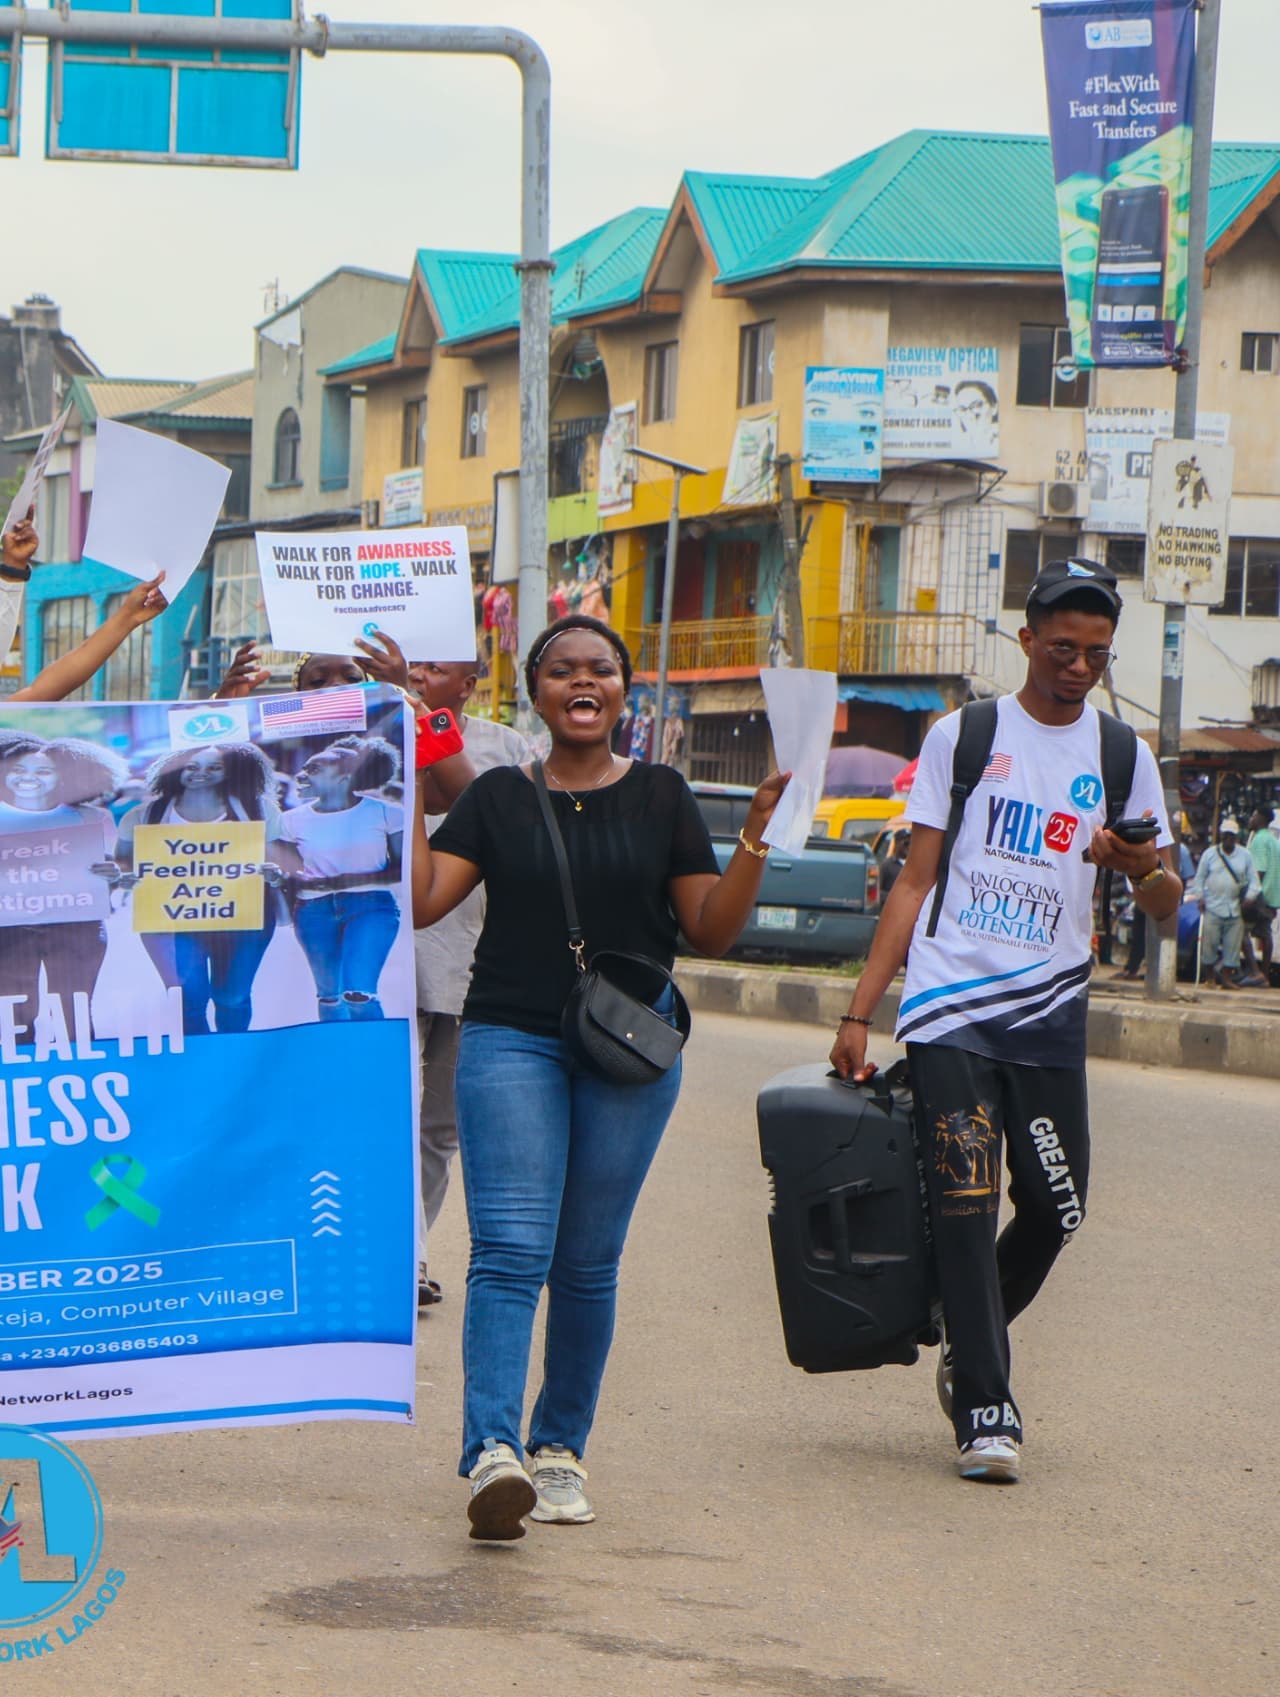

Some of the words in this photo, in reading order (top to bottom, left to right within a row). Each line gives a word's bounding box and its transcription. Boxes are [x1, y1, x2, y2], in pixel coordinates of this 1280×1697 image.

[1085, 73, 1160, 94] #FlexWith
[1069, 101, 1099, 118] Fast
[1102, 98, 1126, 116] and
[1130, 98, 1177, 116] Secure
[1093, 120, 1157, 139] Transfers
[1158, 523, 1173, 537] NO
[1176, 526, 1218, 540] TRADING
[273, 546, 317, 562] WALK
[322, 546, 352, 562] FOR
[357, 540, 456, 561] AWARENESS.
[1175, 540, 1221, 554] HAWKING
[276, 564, 320, 581] WALK
[325, 565, 355, 581] FOR
[360, 561, 406, 580] HOPE.
[412, 559, 458, 577] WALK
[1158, 554, 1172, 565] NO
[1174, 555, 1212, 570] BUYING
[316, 584, 346, 600] FOR
[351, 580, 419, 600] CHANGE.
[986, 795, 1043, 856] YALI
[164, 838, 230, 856] Your
[984, 847, 1027, 864] NATIONAL
[8, 865, 59, 884] the
[137, 861, 257, 880] Feelings
[172, 883, 223, 899] Are
[971, 871, 1064, 905] UNLOCKING
[163, 901, 236, 920] Valid
[971, 887, 1063, 930] YOUTH
[1029, 1117, 1075, 1192] GREAT
[1057, 1194, 1082, 1230] TO
[73, 1261, 163, 1287] 2025
[61, 1296, 189, 1321] Computer
[198, 1287, 284, 1307] Village
[18, 1334, 199, 1360] +2347036865403
[970, 1405, 999, 1430] TO
